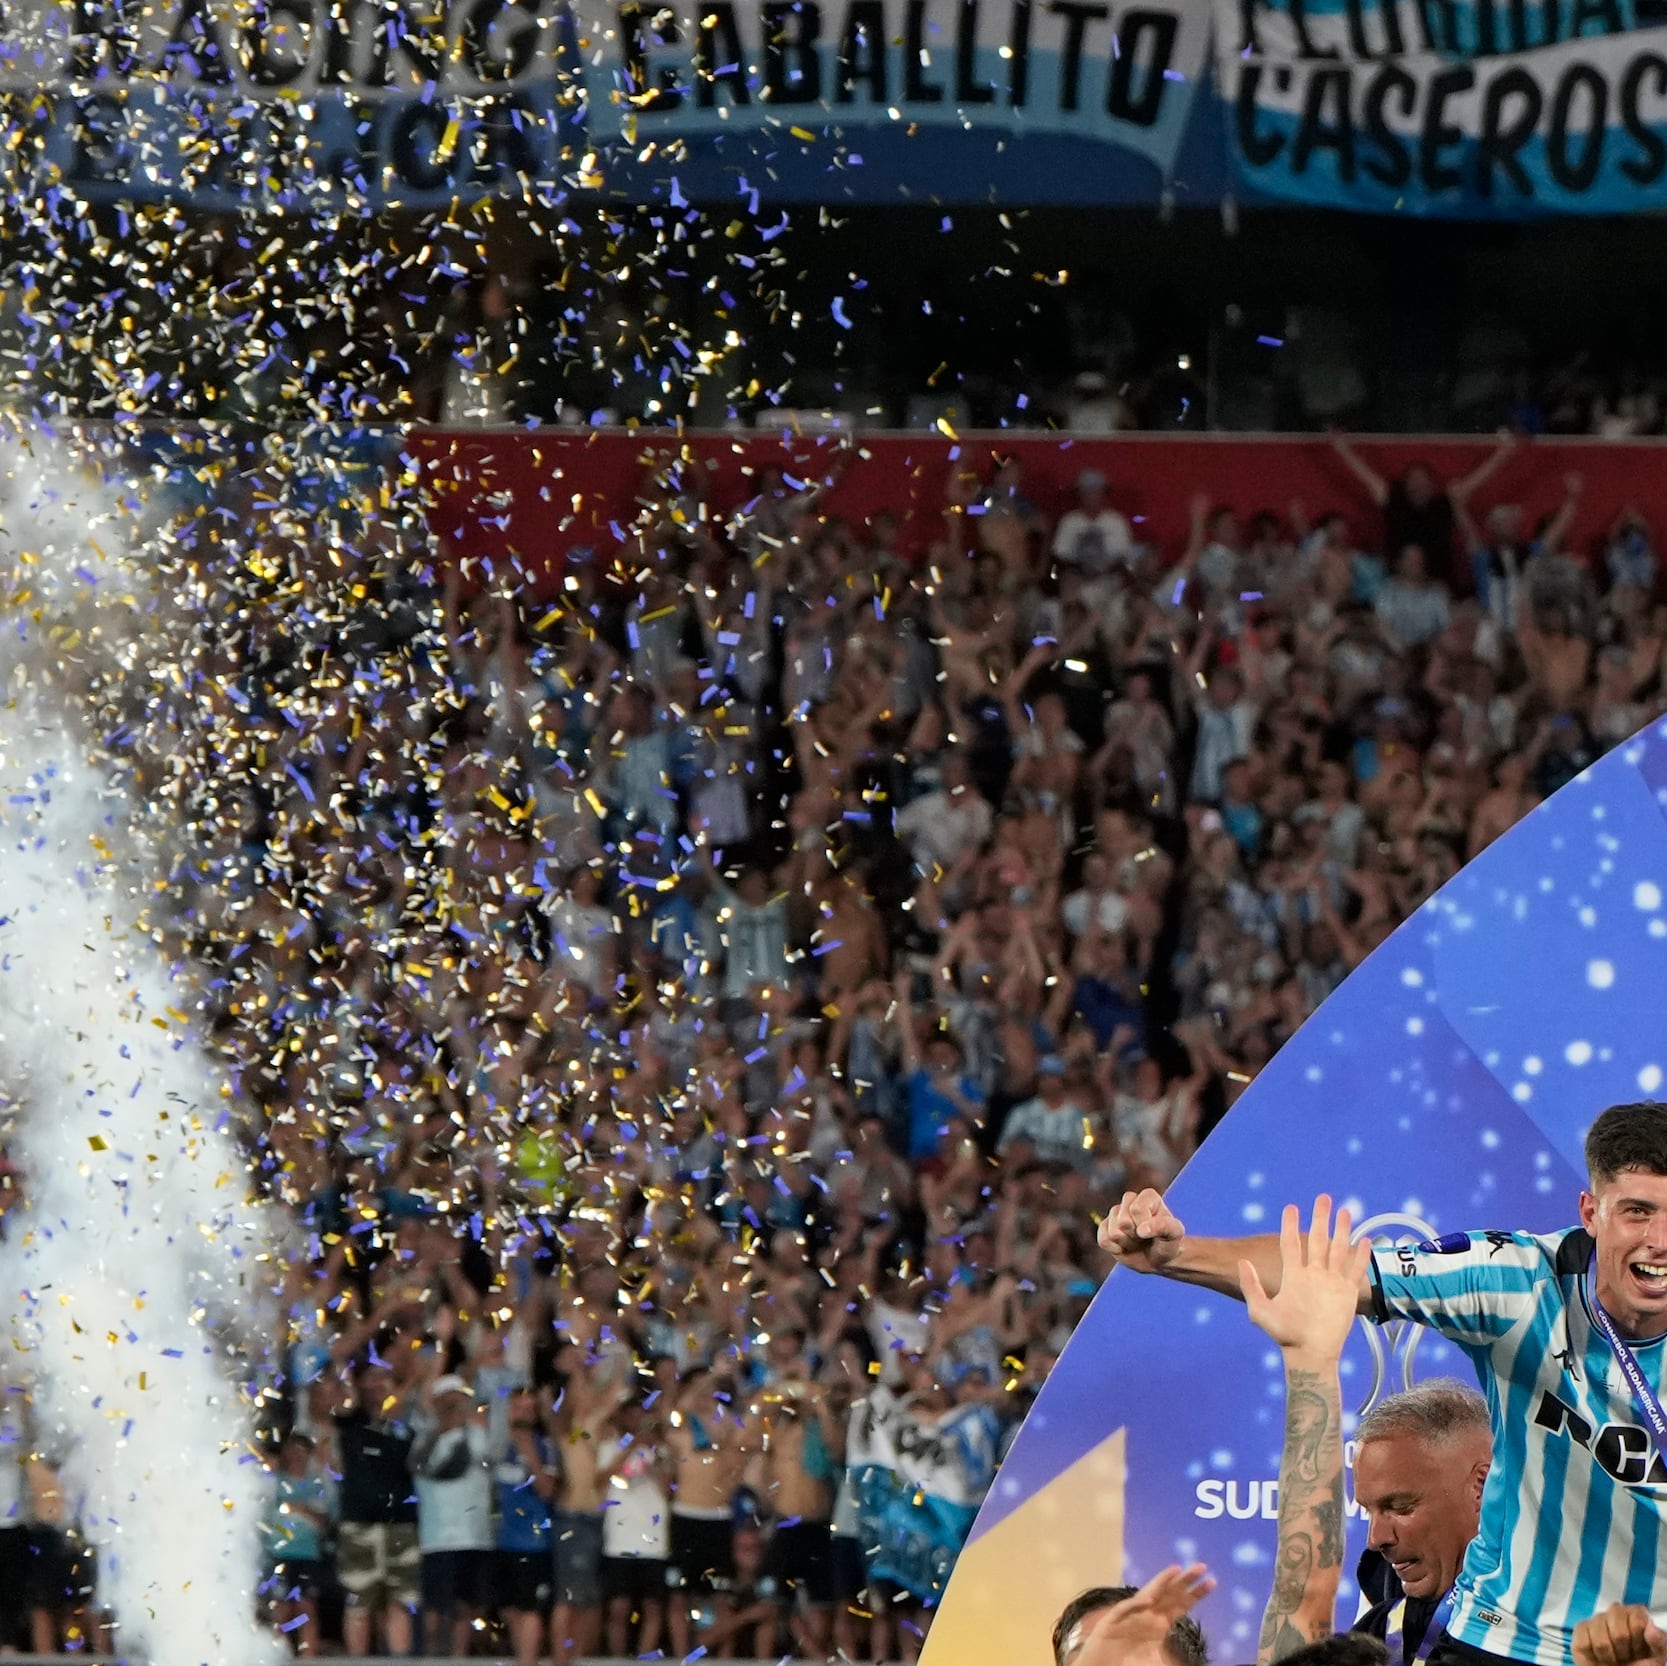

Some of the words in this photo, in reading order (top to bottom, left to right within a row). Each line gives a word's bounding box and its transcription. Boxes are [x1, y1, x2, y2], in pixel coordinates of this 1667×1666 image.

[622, 2, 1175, 126] CABALLITO
[1598, 1310, 1628, 1363] CONMEBOL
[1625, 1362, 1666, 1436] SUDAMERICANA
